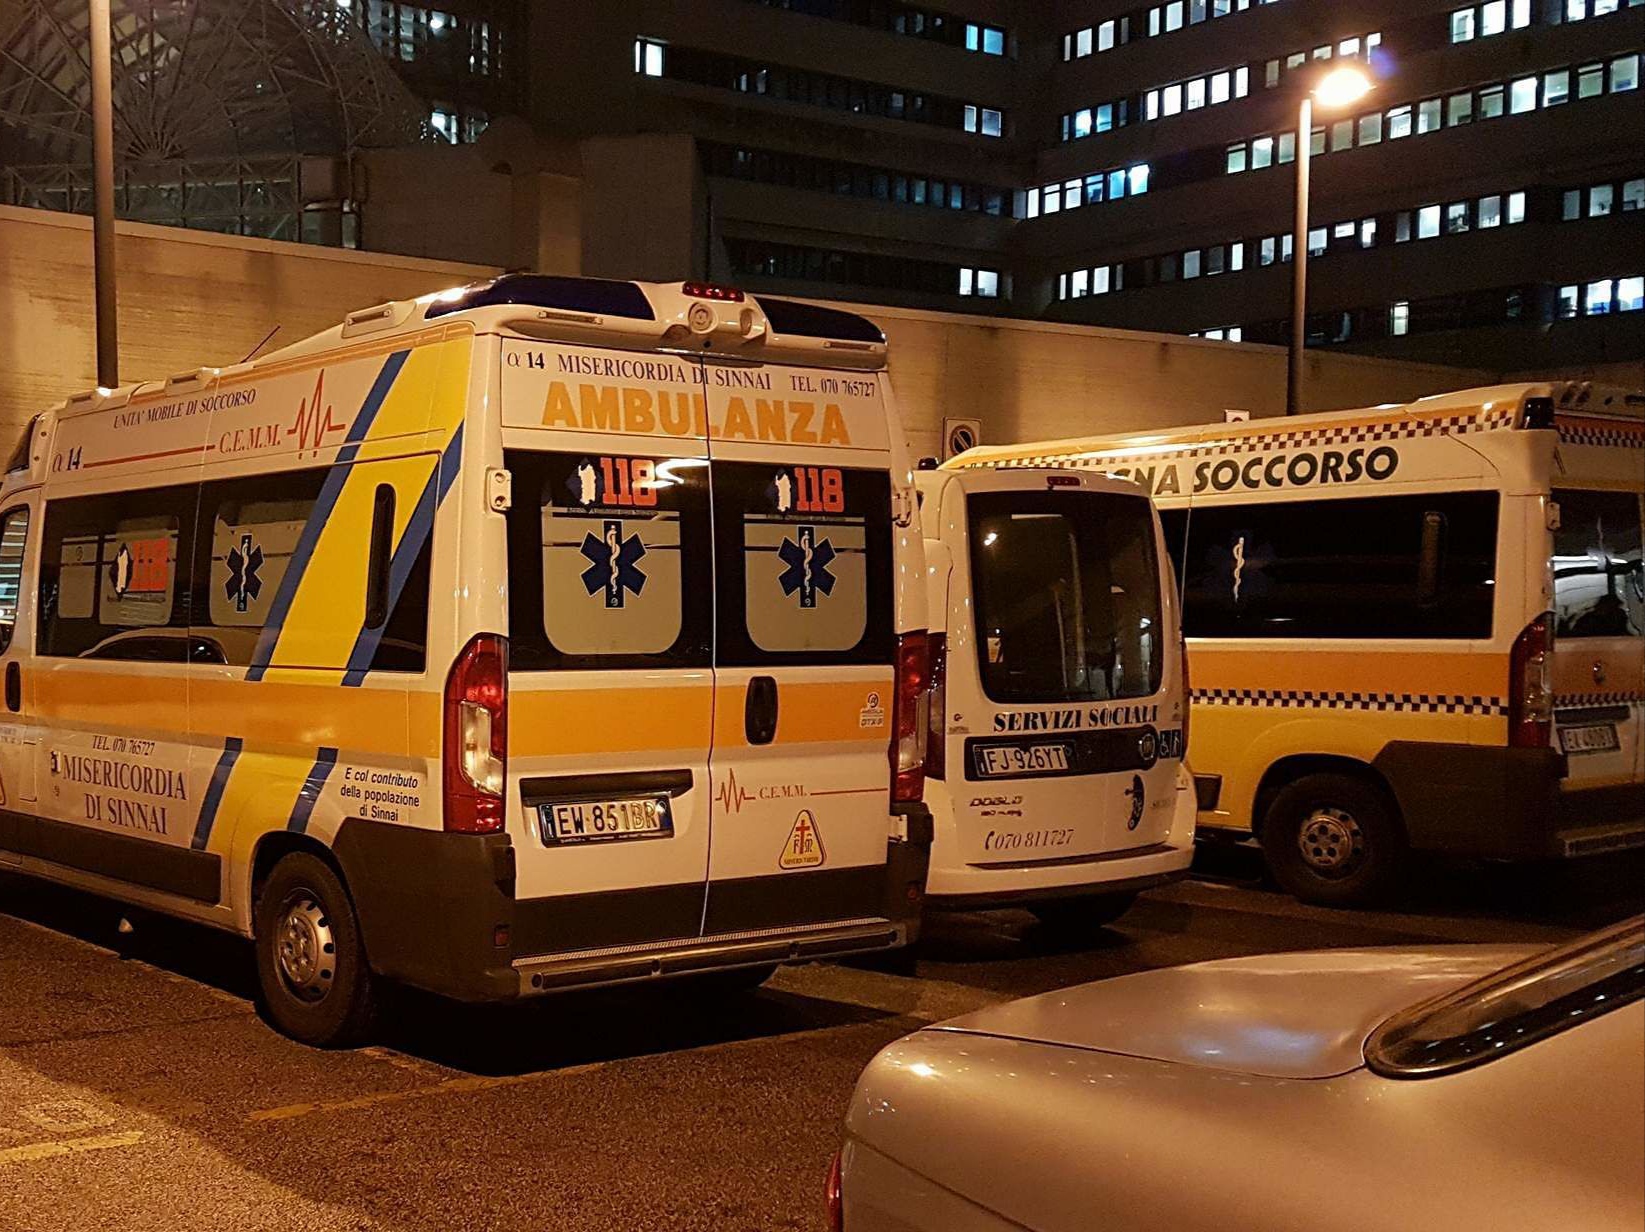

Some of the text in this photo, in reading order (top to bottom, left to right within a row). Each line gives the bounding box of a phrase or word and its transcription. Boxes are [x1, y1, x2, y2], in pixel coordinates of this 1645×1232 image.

[527, 351, 545, 369] 14
[558, 353, 687, 383] MISERICORDIA
[692, 366, 709, 385] DI
[715, 368, 772, 390] SINNAI
[790, 375, 817, 393] TEL.
[820, 378, 839, 394] 070
[842, 380, 876, 398] 765727
[147, 402, 185, 422] MOBILE
[185, 399, 199, 415] DI
[199, 388, 257, 413] SOCCORSO
[541, 381, 852, 446] AMBULANZA
[219, 423, 281, 454] C.E.M.M.
[66, 446, 83, 471] 14
[1193, 446, 1400, 494] SOCCORSO
[600, 457, 658, 507] 118
[794, 467, 844, 513] 118
[993, 705, 1159, 733] SERVIZI SOCIALI
[92, 735, 155, 756] TEL. 070 765727
[63, 754, 187, 800] MISERICORDIA
[345, 767, 418, 789] E col contributo
[340, 783, 420, 807] della popolazione
[84, 792, 168, 835] DI SINNAI
[359, 804, 399, 821] di Sinnai
[995, 829, 1075, 850] 070 811727
